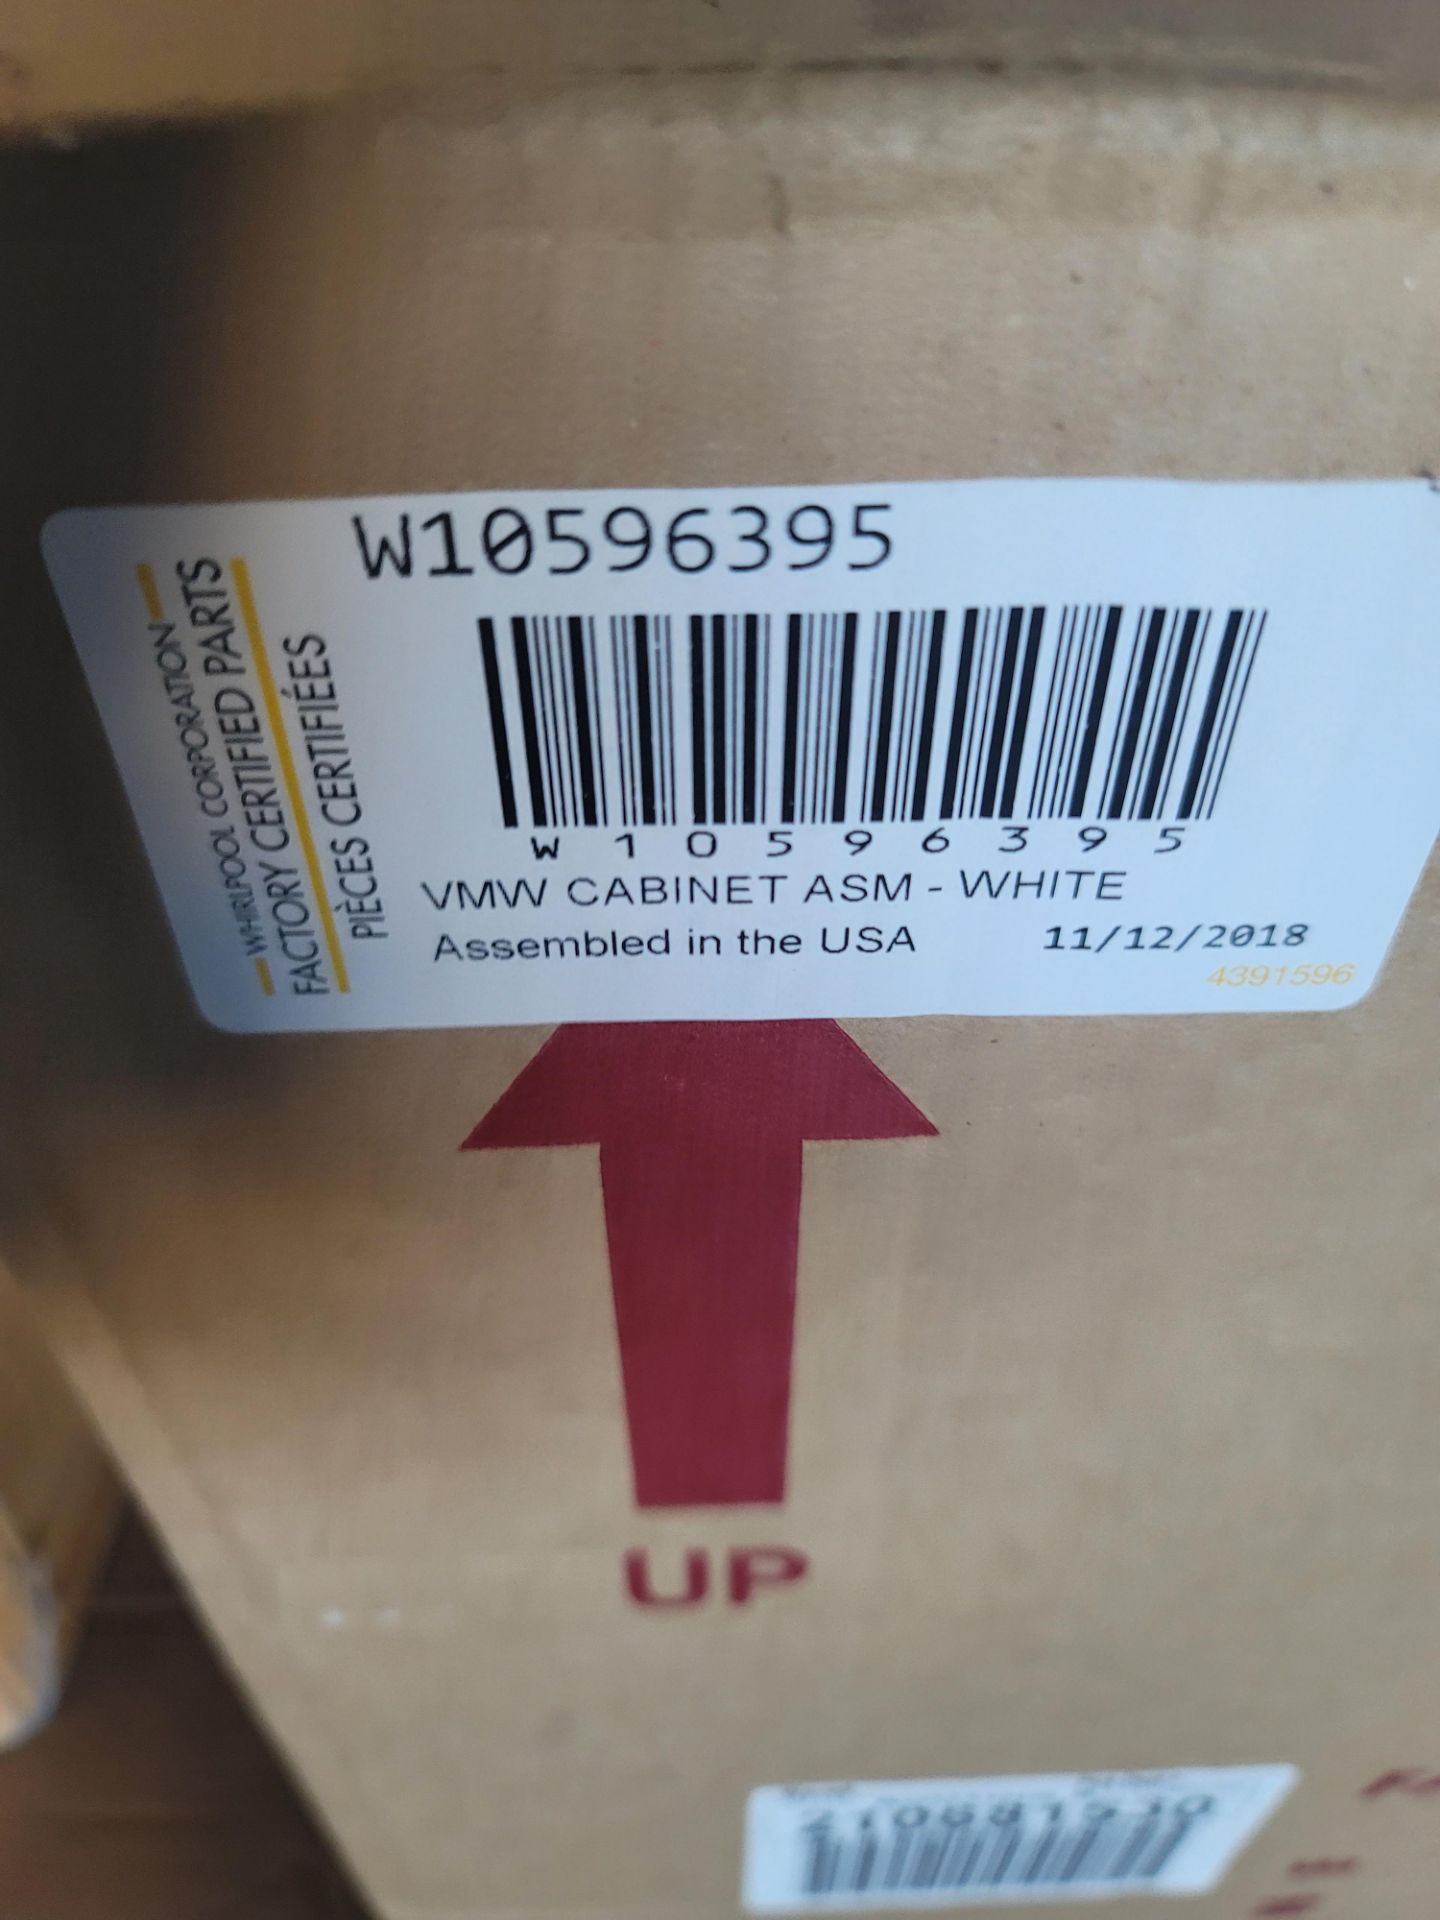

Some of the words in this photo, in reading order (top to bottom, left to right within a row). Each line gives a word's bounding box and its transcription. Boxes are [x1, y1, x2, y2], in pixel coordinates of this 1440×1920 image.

[352, 504, 892, 579] W10596395
[177, 557, 246, 675] PARTS
[150, 623, 228, 817] CORPORATION
[215, 688, 290, 851] CERTIFIED
[282, 633, 362, 827] CERTIFIÉES
[209, 826, 267, 957] WHIRLPOOL
[260, 862, 330, 996] FACTORY
[331, 837, 389, 939] PIÈCES
[420, 878, 548, 911] VMW
[567, 875, 788, 907] CABINET
[803, 872, 912, 904] ASM
[960, 870, 1127, 900] WHITE
[1043, 923, 1309, 953] 11/12/2018
[434, 929, 671, 961] Assembled
[688, 929, 722, 956] in
[737, 929, 803, 956] the
[820, 926, 916, 955] USA
[1206, 963, 1357, 987] 4391596
[625, 1546, 809, 1612] UP
